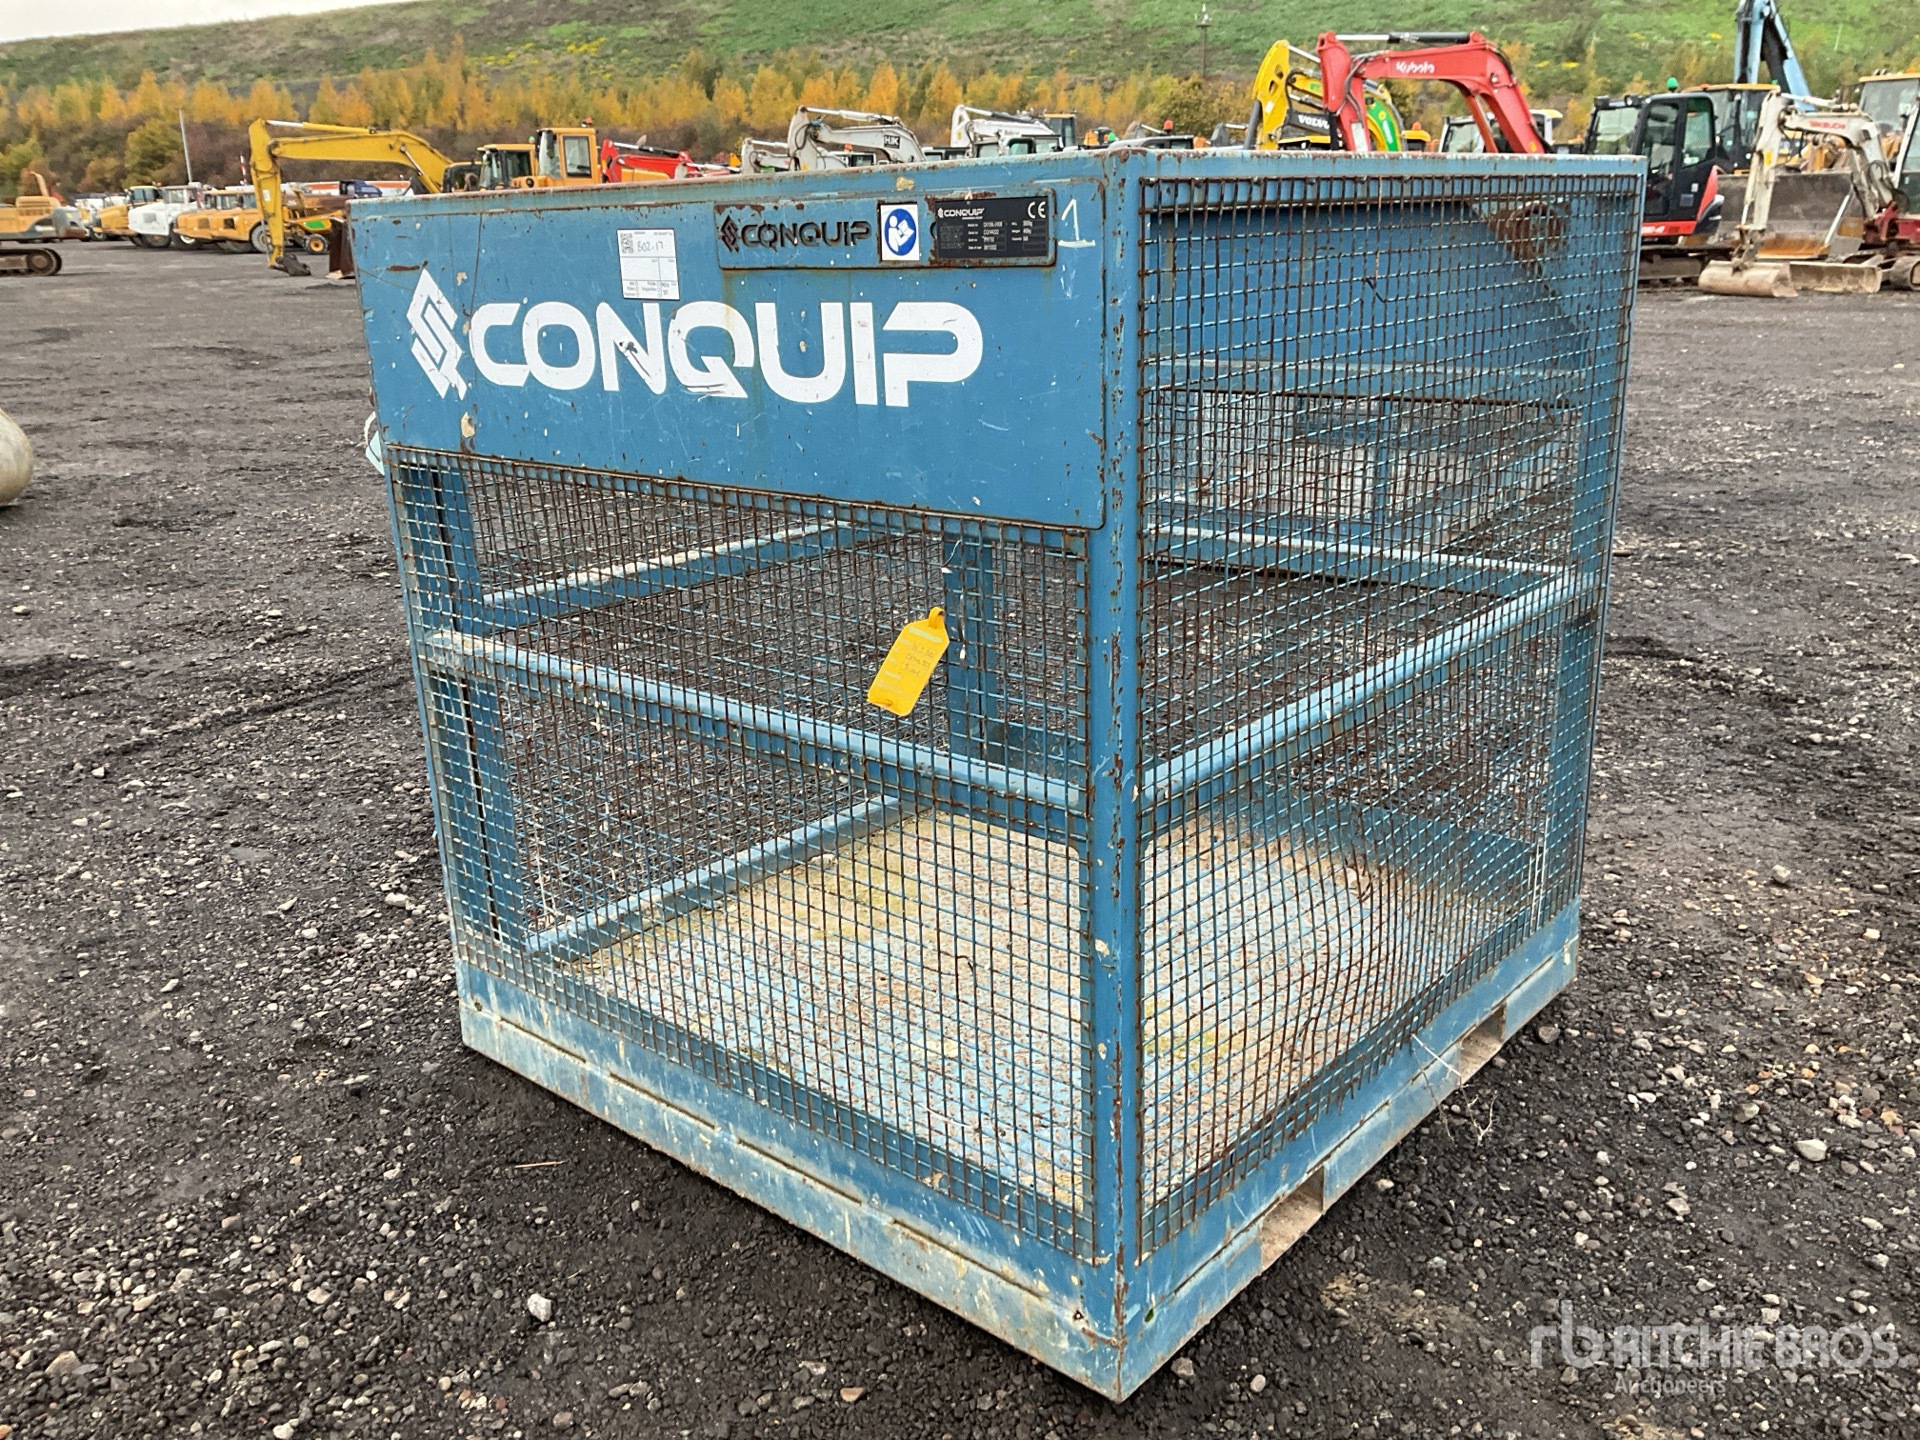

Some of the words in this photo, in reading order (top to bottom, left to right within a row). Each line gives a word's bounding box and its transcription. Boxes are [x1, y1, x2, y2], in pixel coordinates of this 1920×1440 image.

[1395, 61, 1436, 74] Kubota
[943, 207, 985, 218] CONQUIP
[1027, 201, 1047, 219] CE
[740, 220, 872, 248] CONQUIP
[469, 301, 984, 408] CONQUIP
